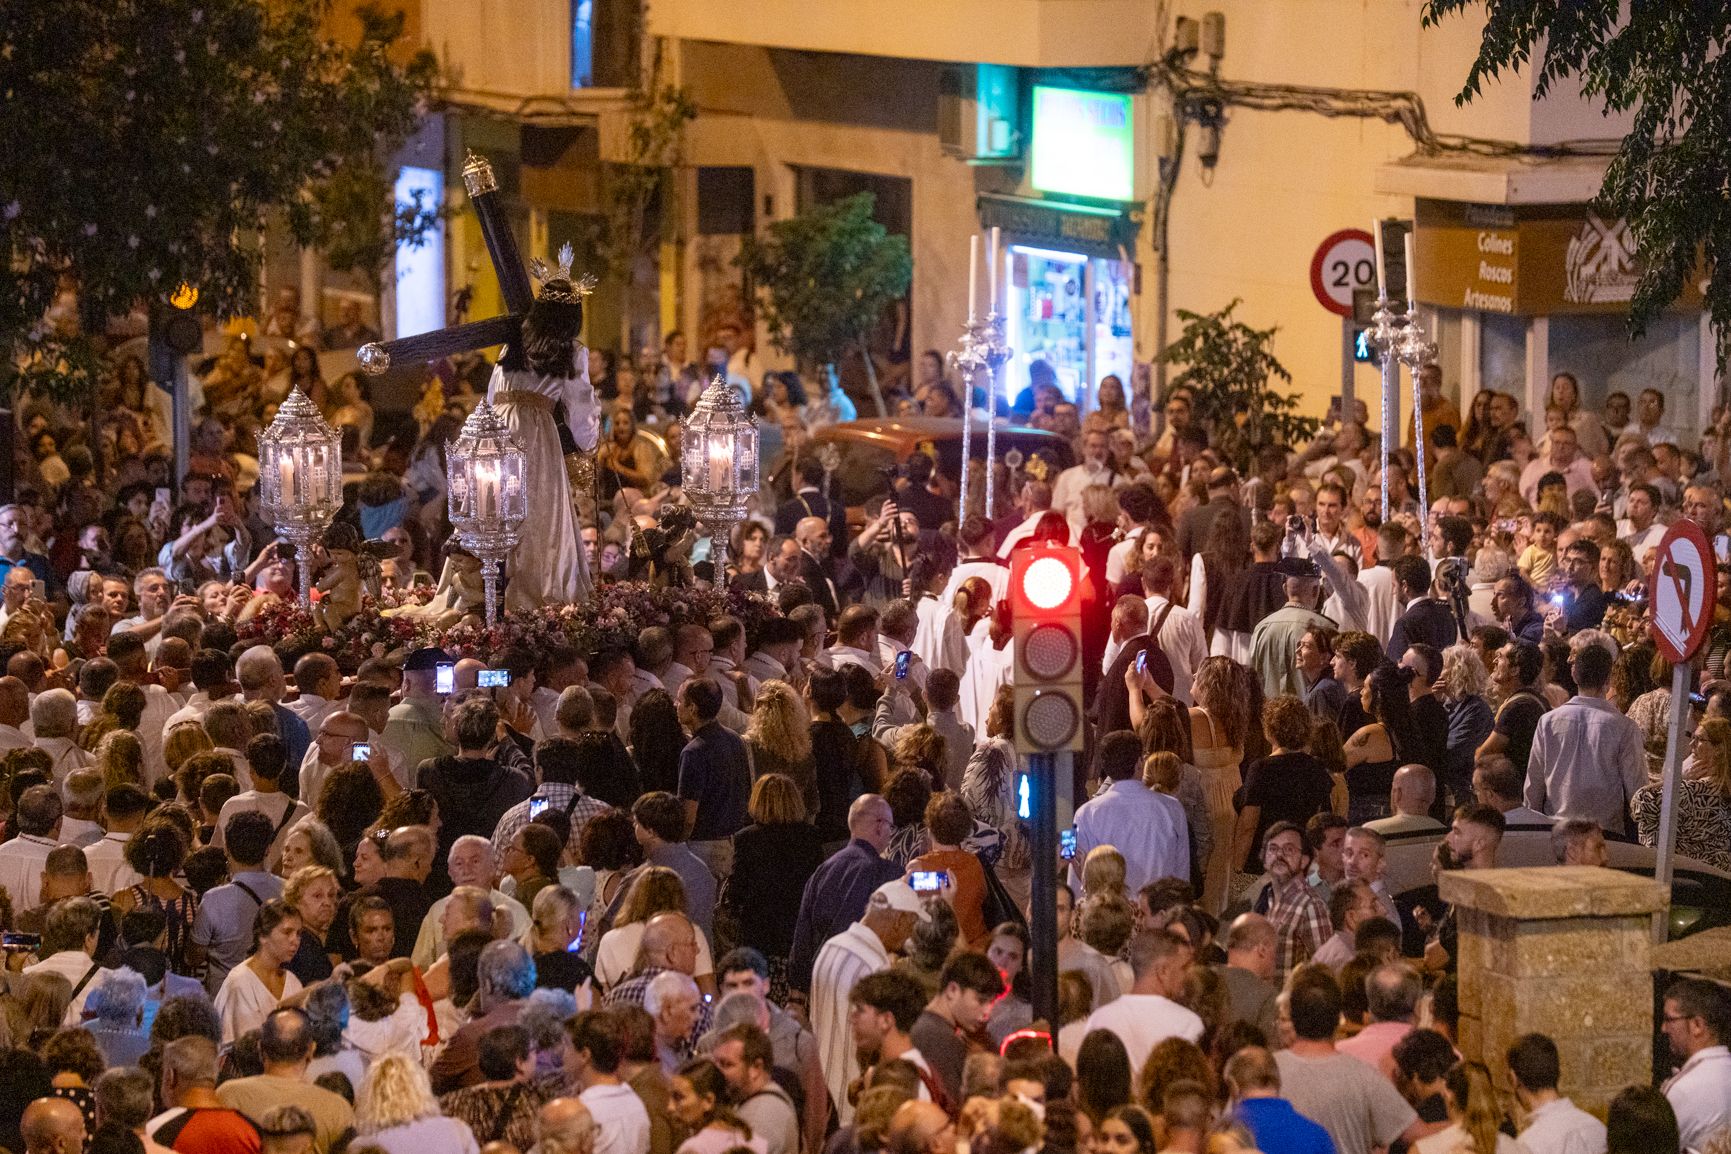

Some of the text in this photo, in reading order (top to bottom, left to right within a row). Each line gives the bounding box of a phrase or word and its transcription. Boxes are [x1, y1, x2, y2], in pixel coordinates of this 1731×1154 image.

[1478, 231, 1513, 255] Colines
[1332, 260, 1373, 287] 20
[1479, 260, 1512, 285] Roscos
[1464, 287, 1512, 313] Artesanos
